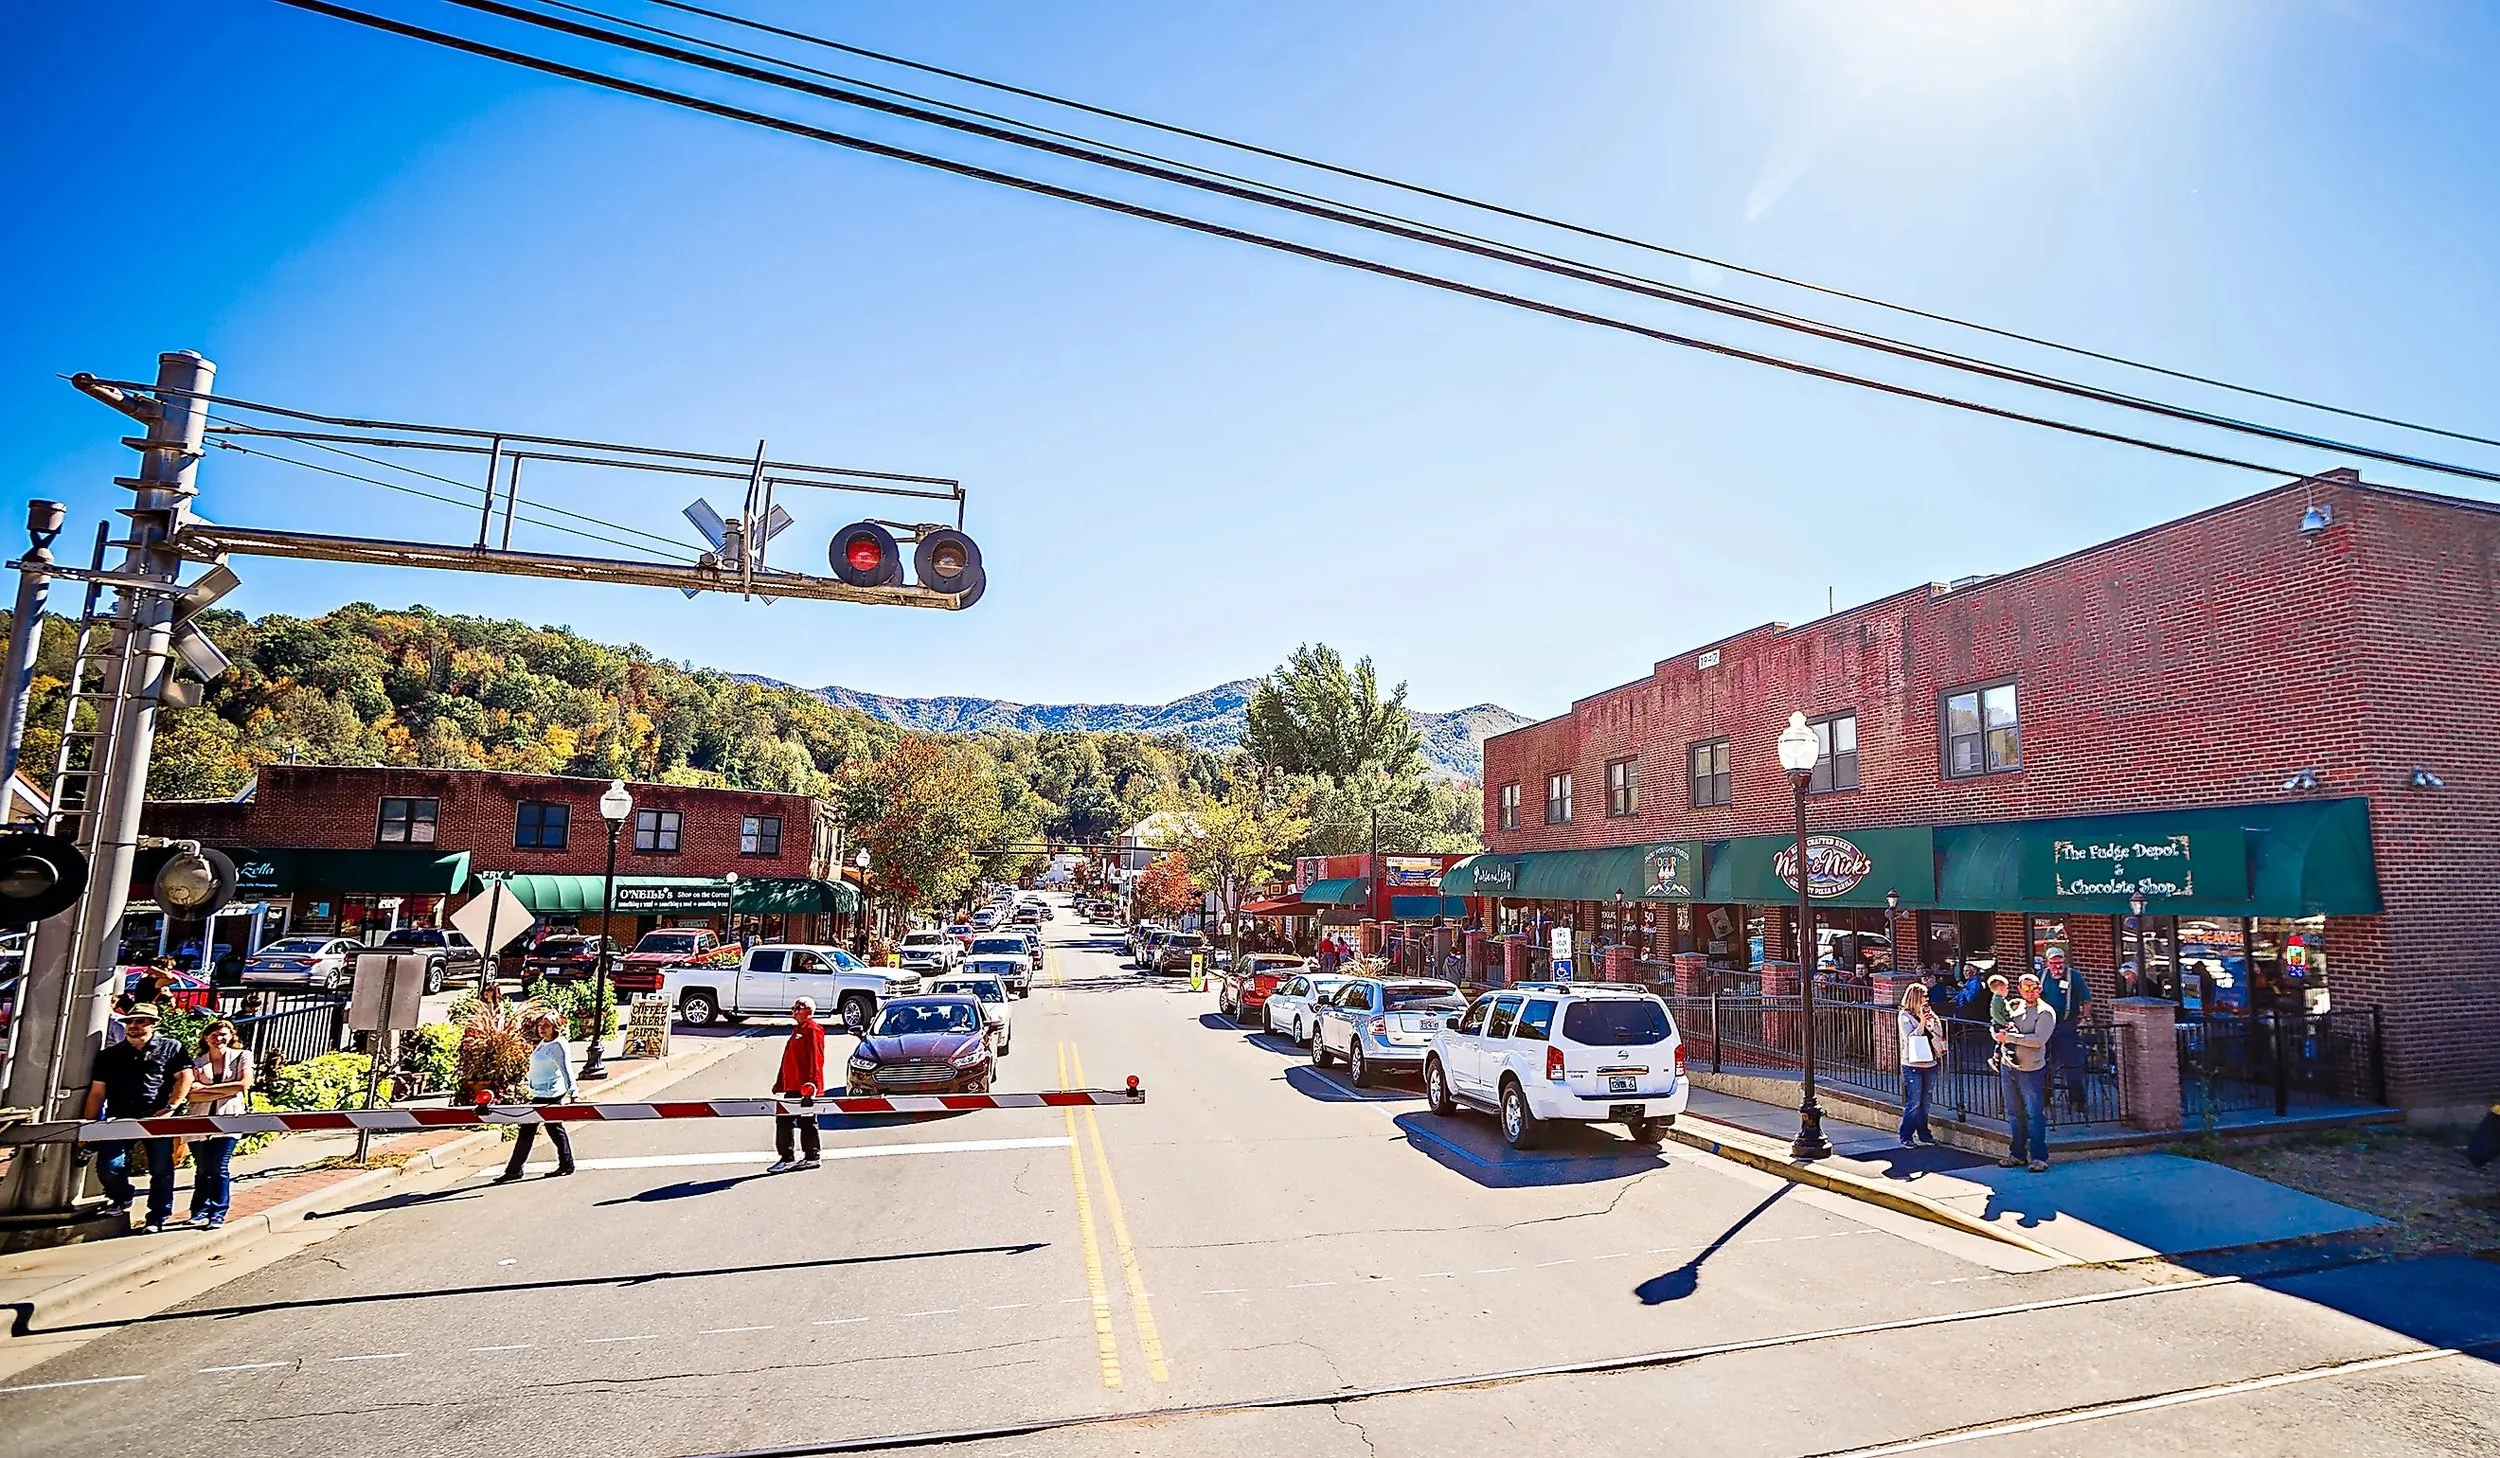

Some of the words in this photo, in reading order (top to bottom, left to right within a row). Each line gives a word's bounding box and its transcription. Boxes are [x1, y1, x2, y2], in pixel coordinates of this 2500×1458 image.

[2062, 844, 2086, 860] The
[2088, 842, 2130, 861] Fudge
[2131, 842, 2180, 860] Depot
[1811, 858, 1822, 873] &
[1822, 848, 1872, 877] Nick's
[482, 870, 505, 879] FRY
[2070, 879, 2136, 895] Chocolate
[2138, 878, 2176, 897] Shop
[677, 891, 692, 899] Shop
[701, 891, 711, 899] the
[632, 1005, 669, 1015] COFFEE
[629, 1014, 667, 1026] BAKERY
[633, 1027, 660, 1037] GIFTS
